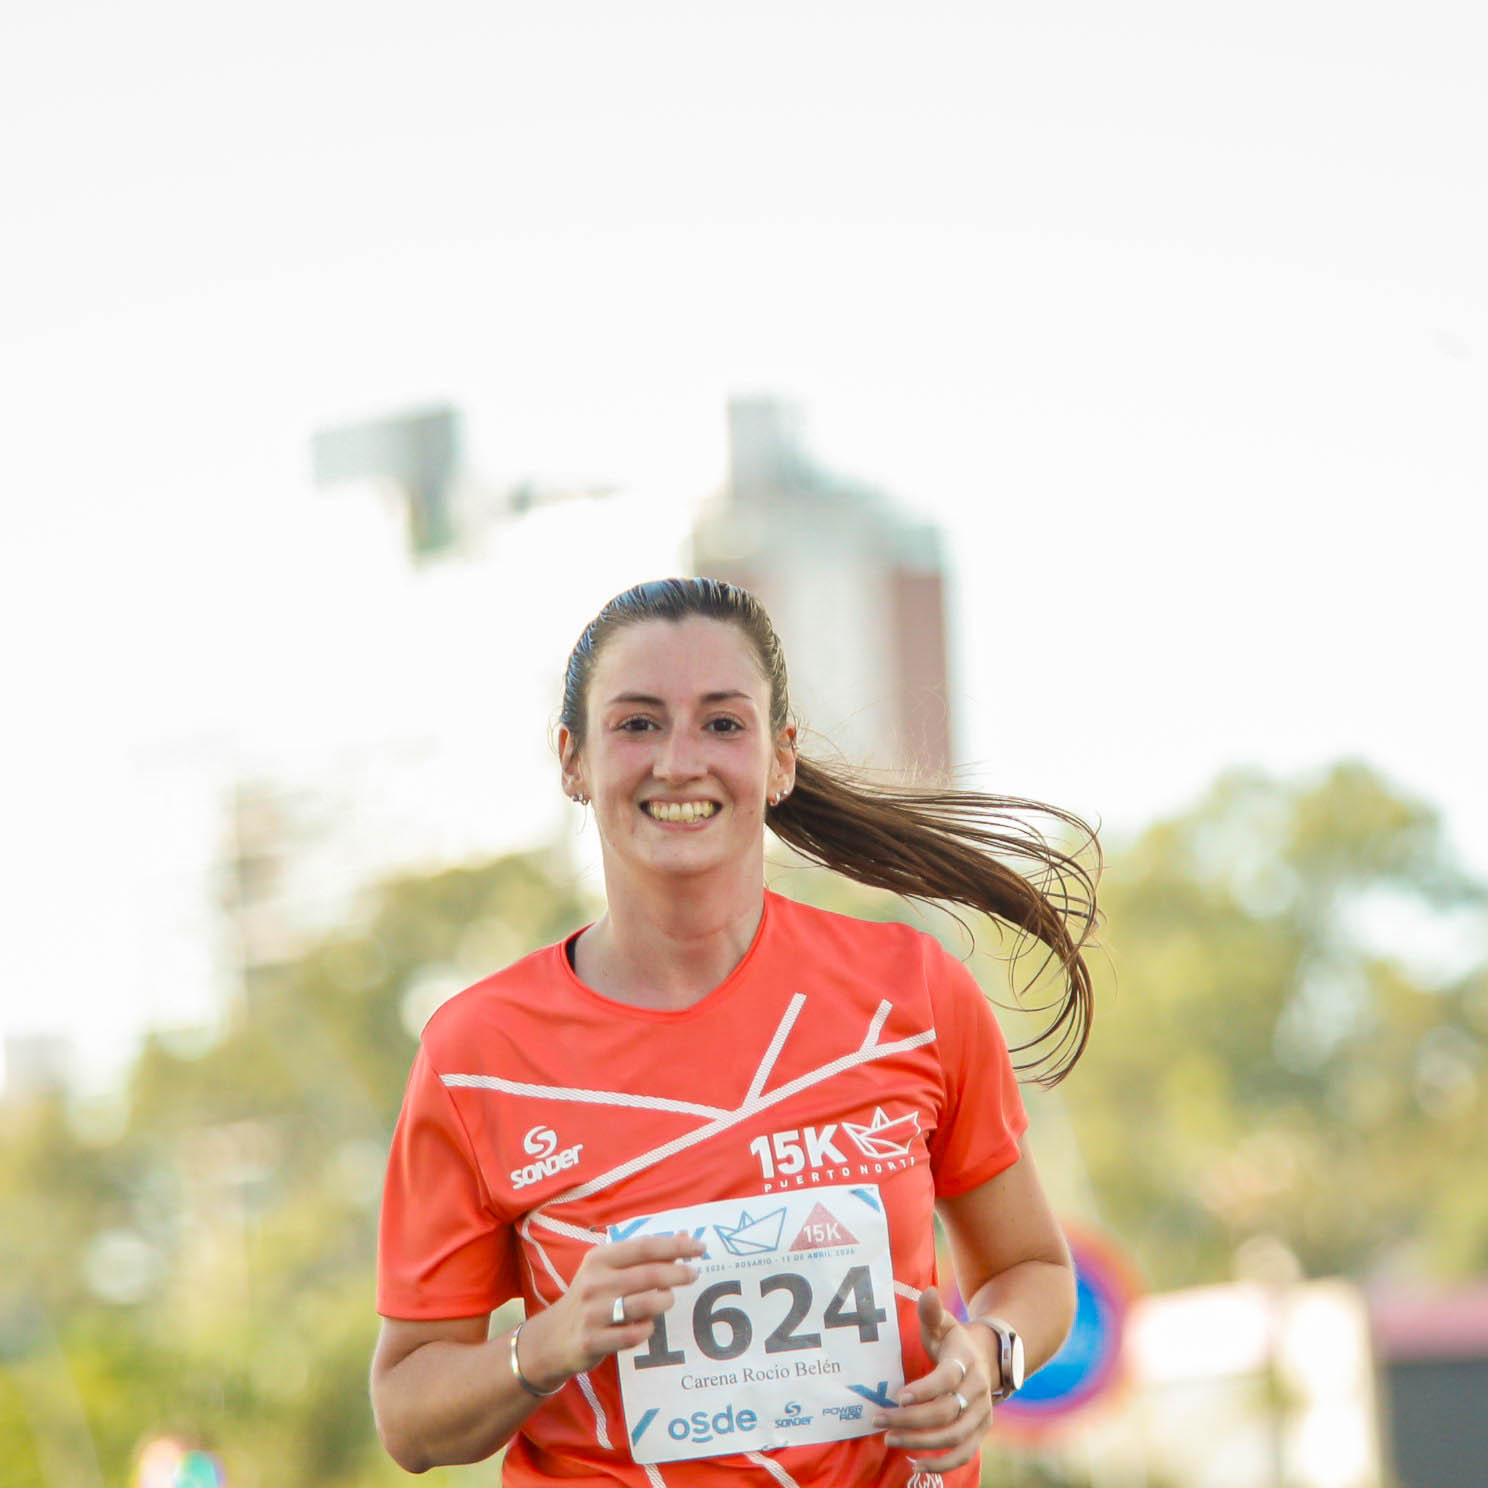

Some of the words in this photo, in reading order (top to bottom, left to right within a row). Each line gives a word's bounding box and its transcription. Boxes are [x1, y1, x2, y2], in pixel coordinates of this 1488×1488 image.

[750, 1124, 848, 1179] 15K
[764, 1167, 851, 1193] PUERTO
[803, 1223, 842, 1243] 15K
[735, 1257, 773, 1269] ROSARIO
[807, 1249, 832, 1259] ABRIL
[633, 1264, 888, 1371] 1624
[681, 1374, 738, 1391] Carena
[794, 1358, 842, 1377] Belén
[668, 1402, 758, 1443] osde
